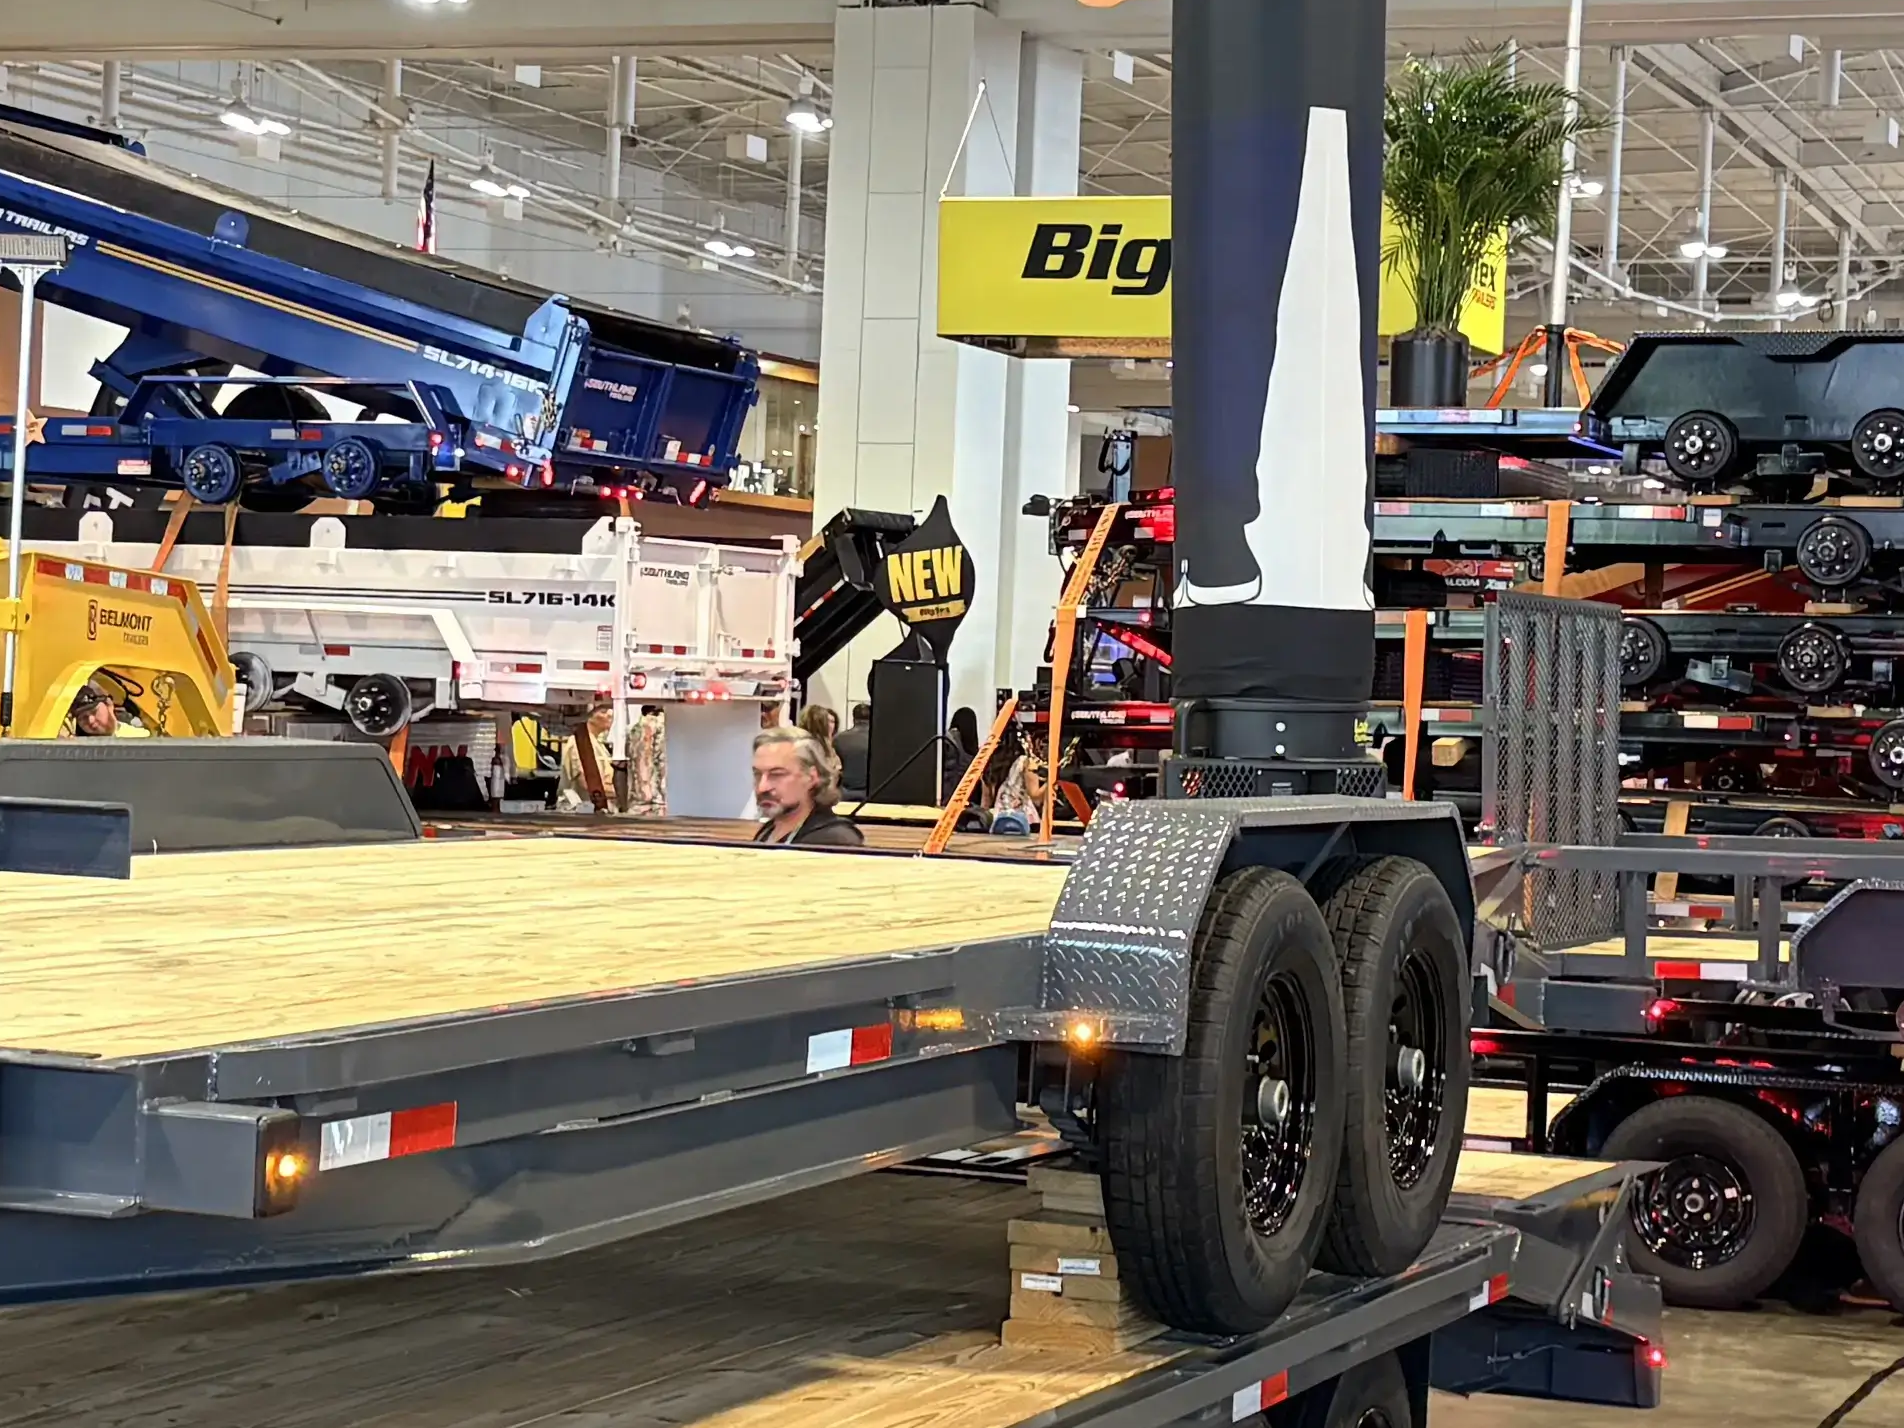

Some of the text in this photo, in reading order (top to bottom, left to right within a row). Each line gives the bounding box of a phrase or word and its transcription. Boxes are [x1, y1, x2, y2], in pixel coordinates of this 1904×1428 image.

[1021, 224, 1174, 295] Big
[887, 545, 962, 603] NEW
[489, 591, 615, 607] SL716-14K
[100, 609, 152, 632] BELMONT
